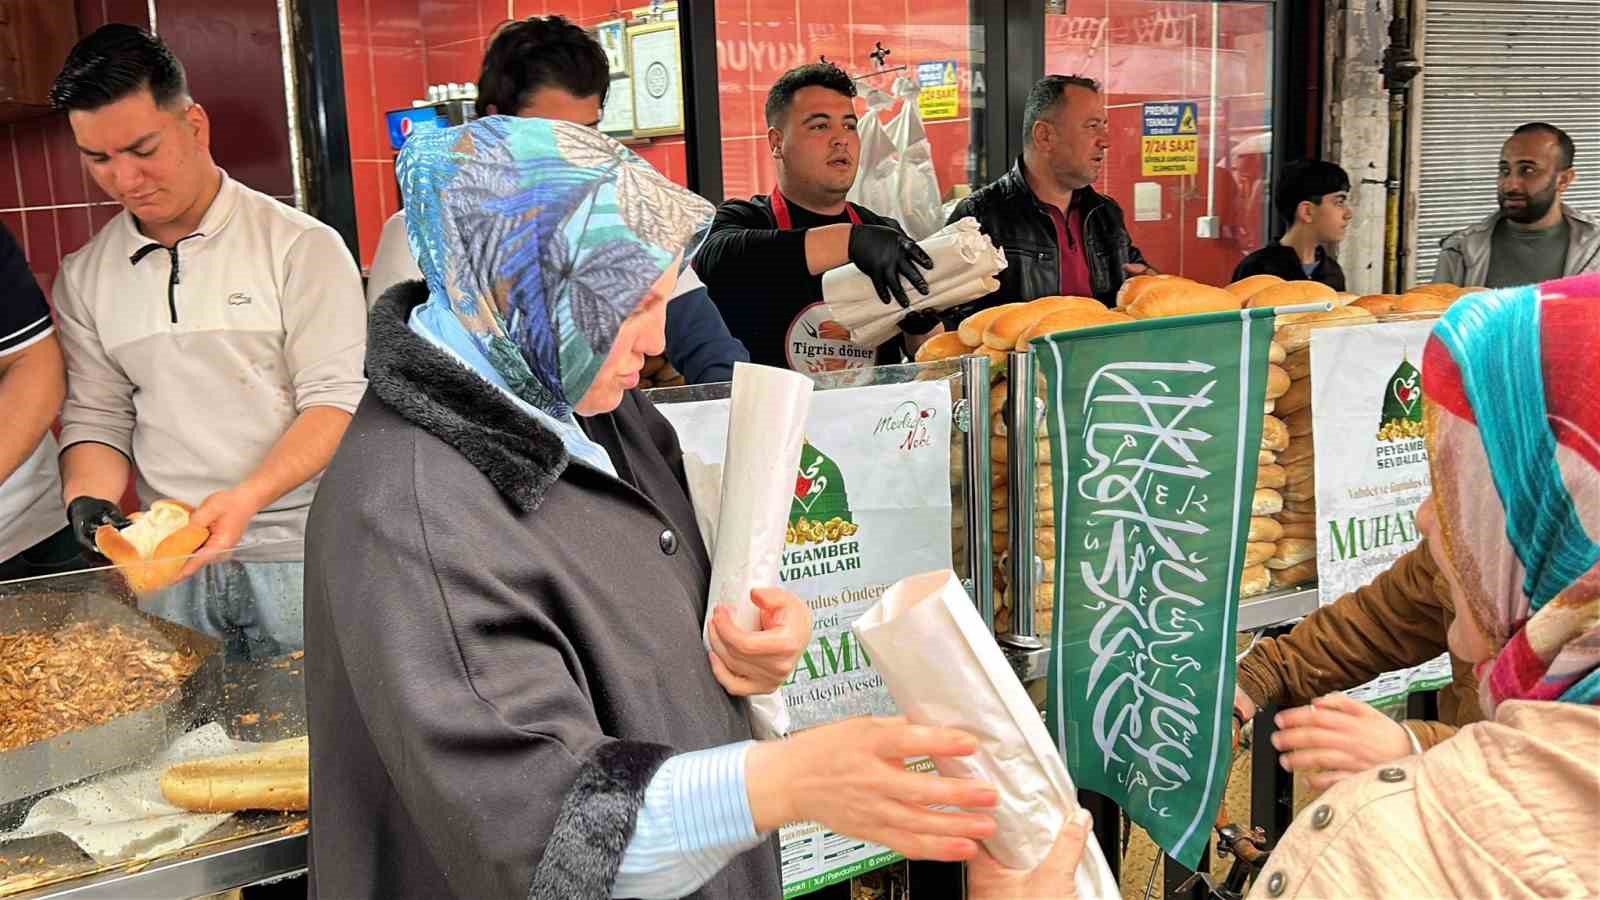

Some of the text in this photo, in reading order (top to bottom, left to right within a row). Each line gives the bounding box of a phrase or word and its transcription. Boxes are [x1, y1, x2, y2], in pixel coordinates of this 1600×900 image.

[1145, 139, 1196, 152] 7/24 SAAT
[793, 342, 874, 359] Tigris döner
[1376, 440, 1424, 457] PEYGAMB
[1377, 452, 1427, 469] SEVDALILA
[782, 541, 859, 566] YGAMBER
[779, 556, 862, 582] VDALILARI
[841, 583, 893, 604] Önderi
[848, 674, 887, 691] Vesell
